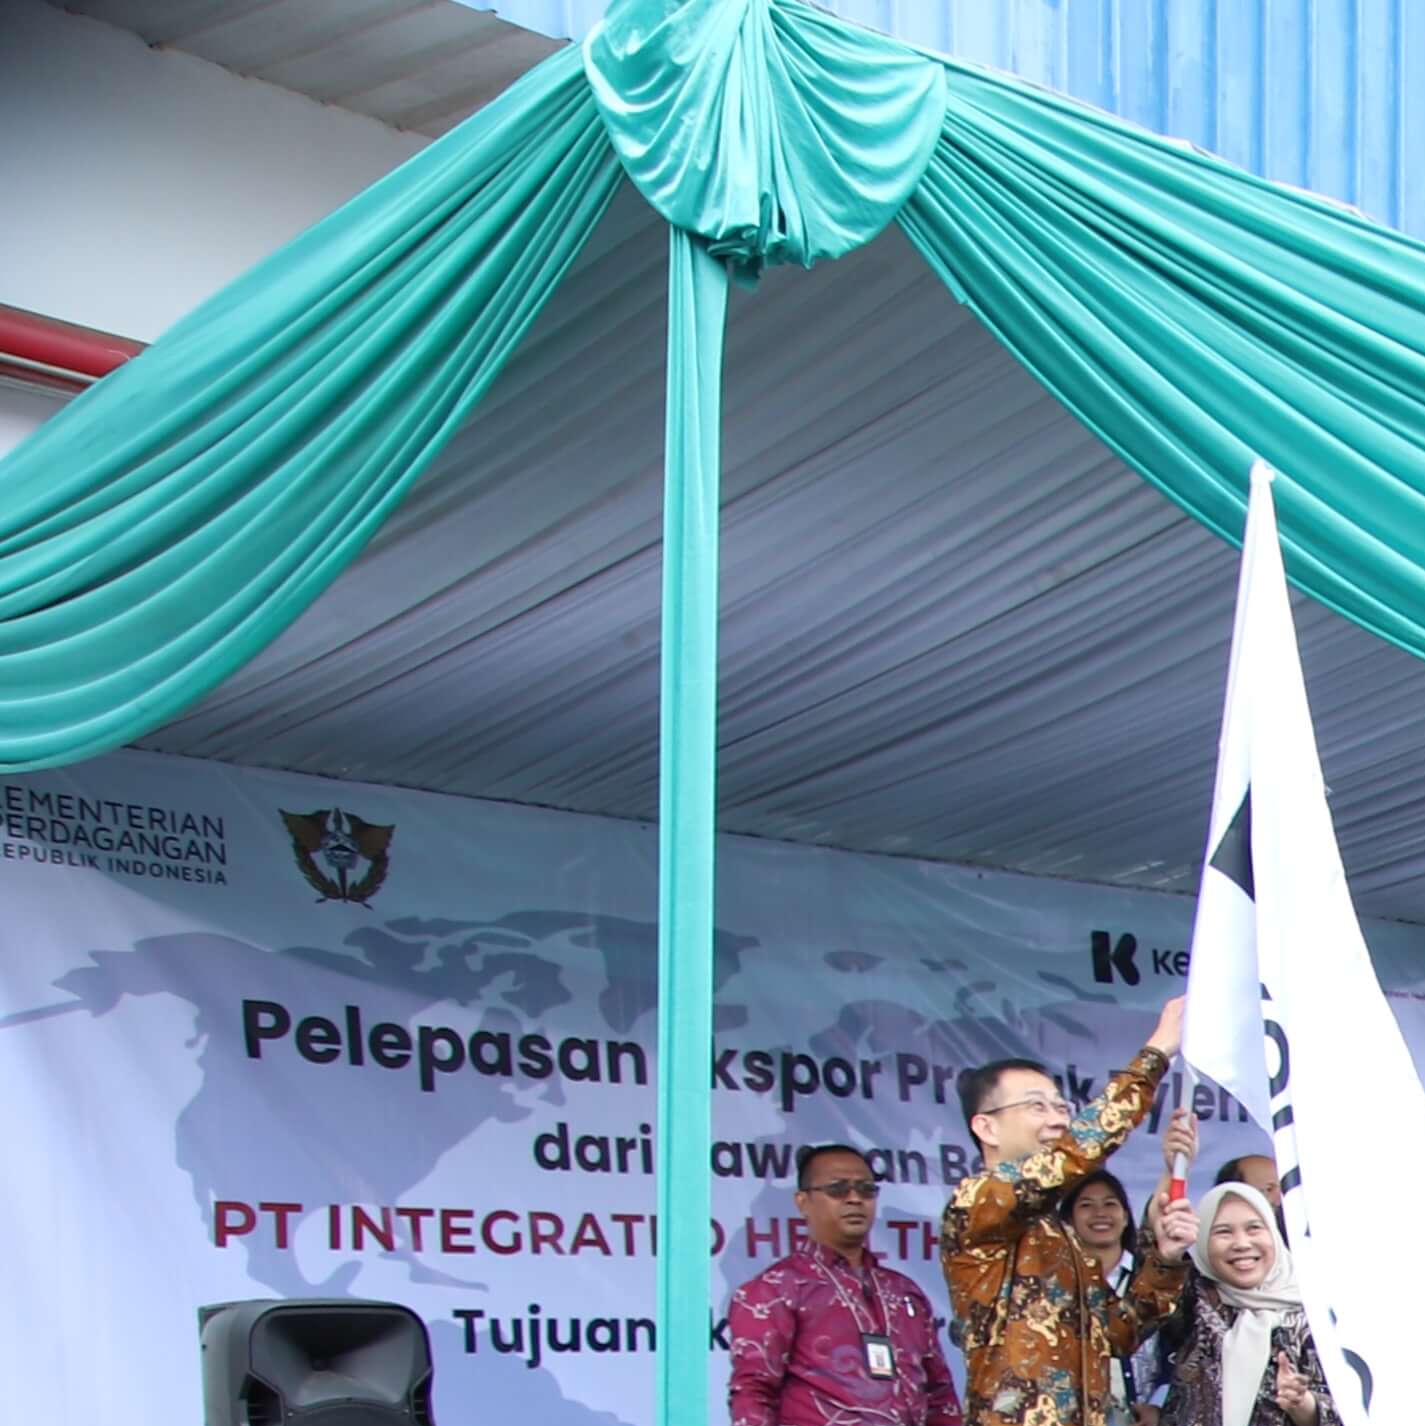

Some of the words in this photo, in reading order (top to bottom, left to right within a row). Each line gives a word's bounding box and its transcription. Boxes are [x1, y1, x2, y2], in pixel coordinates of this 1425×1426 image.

[3, 785, 225, 840] EMENTERIAN
[0, 842, 101, 870] EPUBLIK
[108, 857, 228, 886] INDONESIA
[242, 999, 648, 1092] Pelepasan
[711, 1036, 882, 1112] kspor
[533, 1122, 654, 1174] dari
[213, 1201, 303, 1250] PT
[453, 1304, 656, 1368] Tujuan
